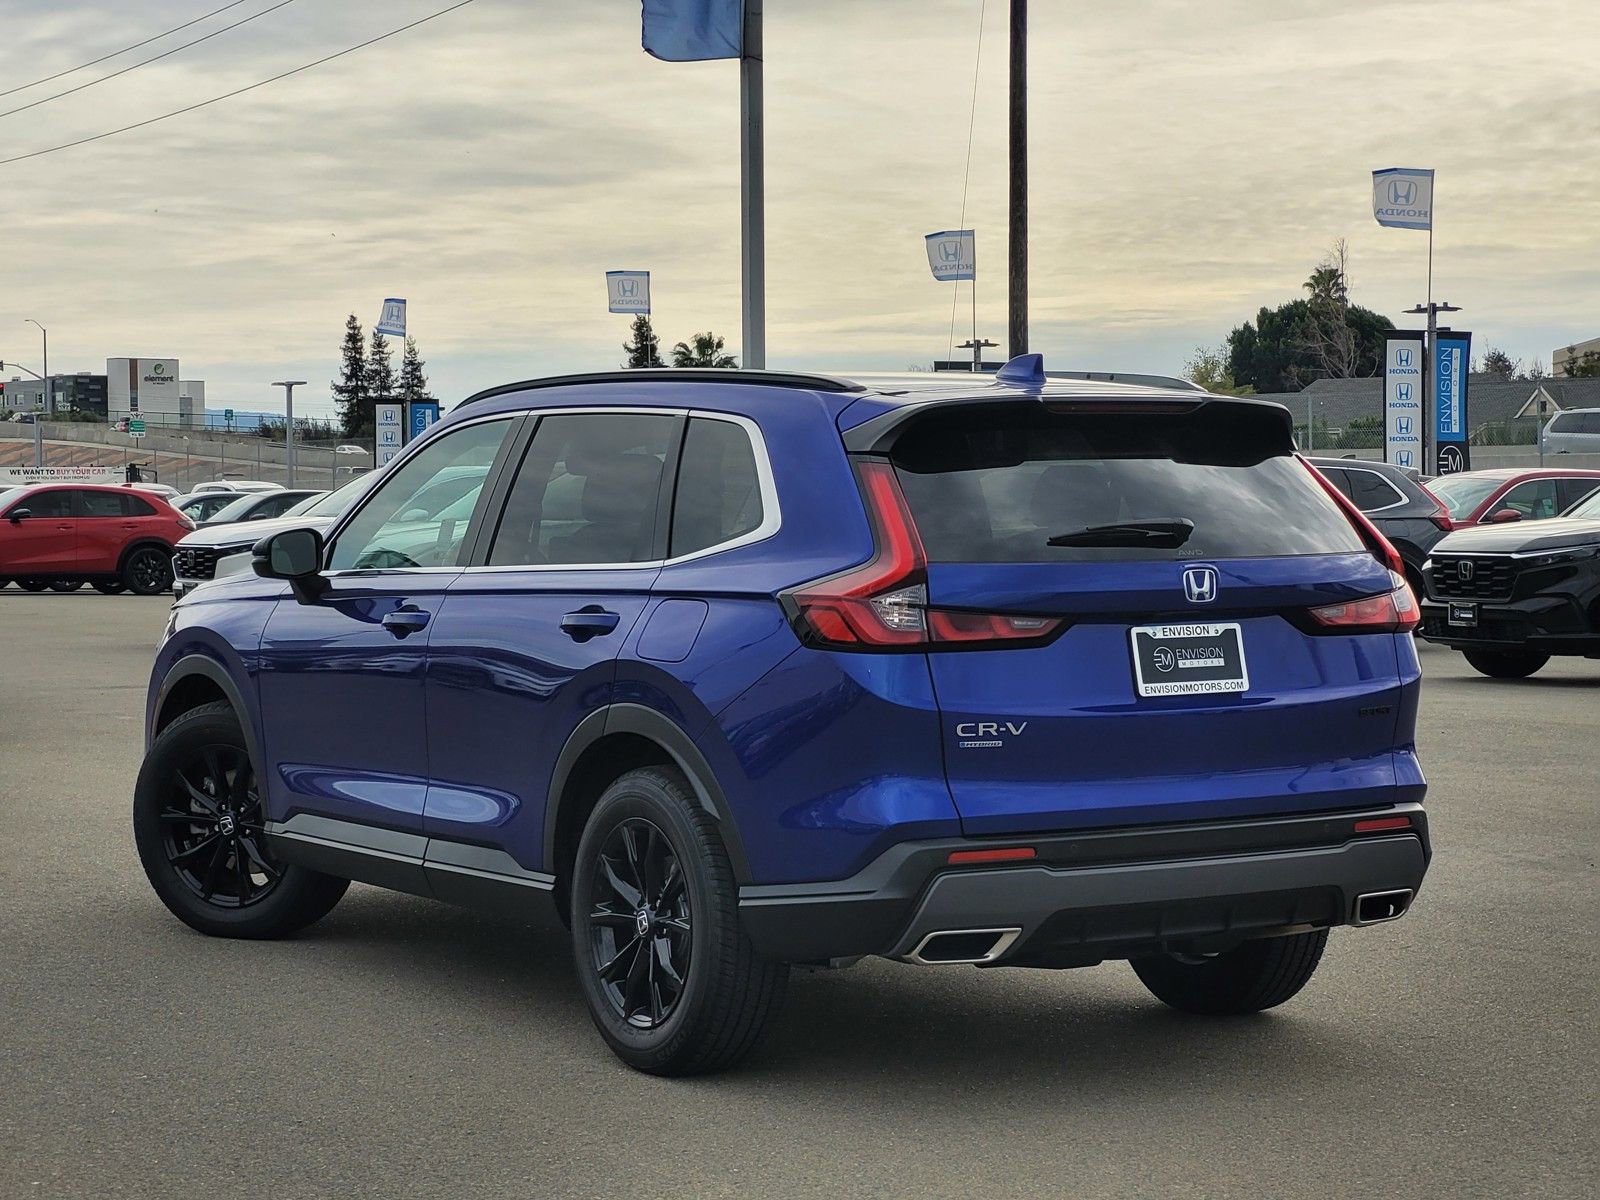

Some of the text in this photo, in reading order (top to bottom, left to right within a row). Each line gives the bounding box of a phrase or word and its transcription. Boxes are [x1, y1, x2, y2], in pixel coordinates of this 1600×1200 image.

[144, 374, 174, 382] element
[1440, 347, 1451, 433] ENVISION
[1162, 625, 1210, 637] ENVISION
[1175, 647, 1224, 660] ENVISION
[1144, 681, 1245, 695] ENVISIONMOTORS.COM
[956, 721, 1028, 737] CR-V
